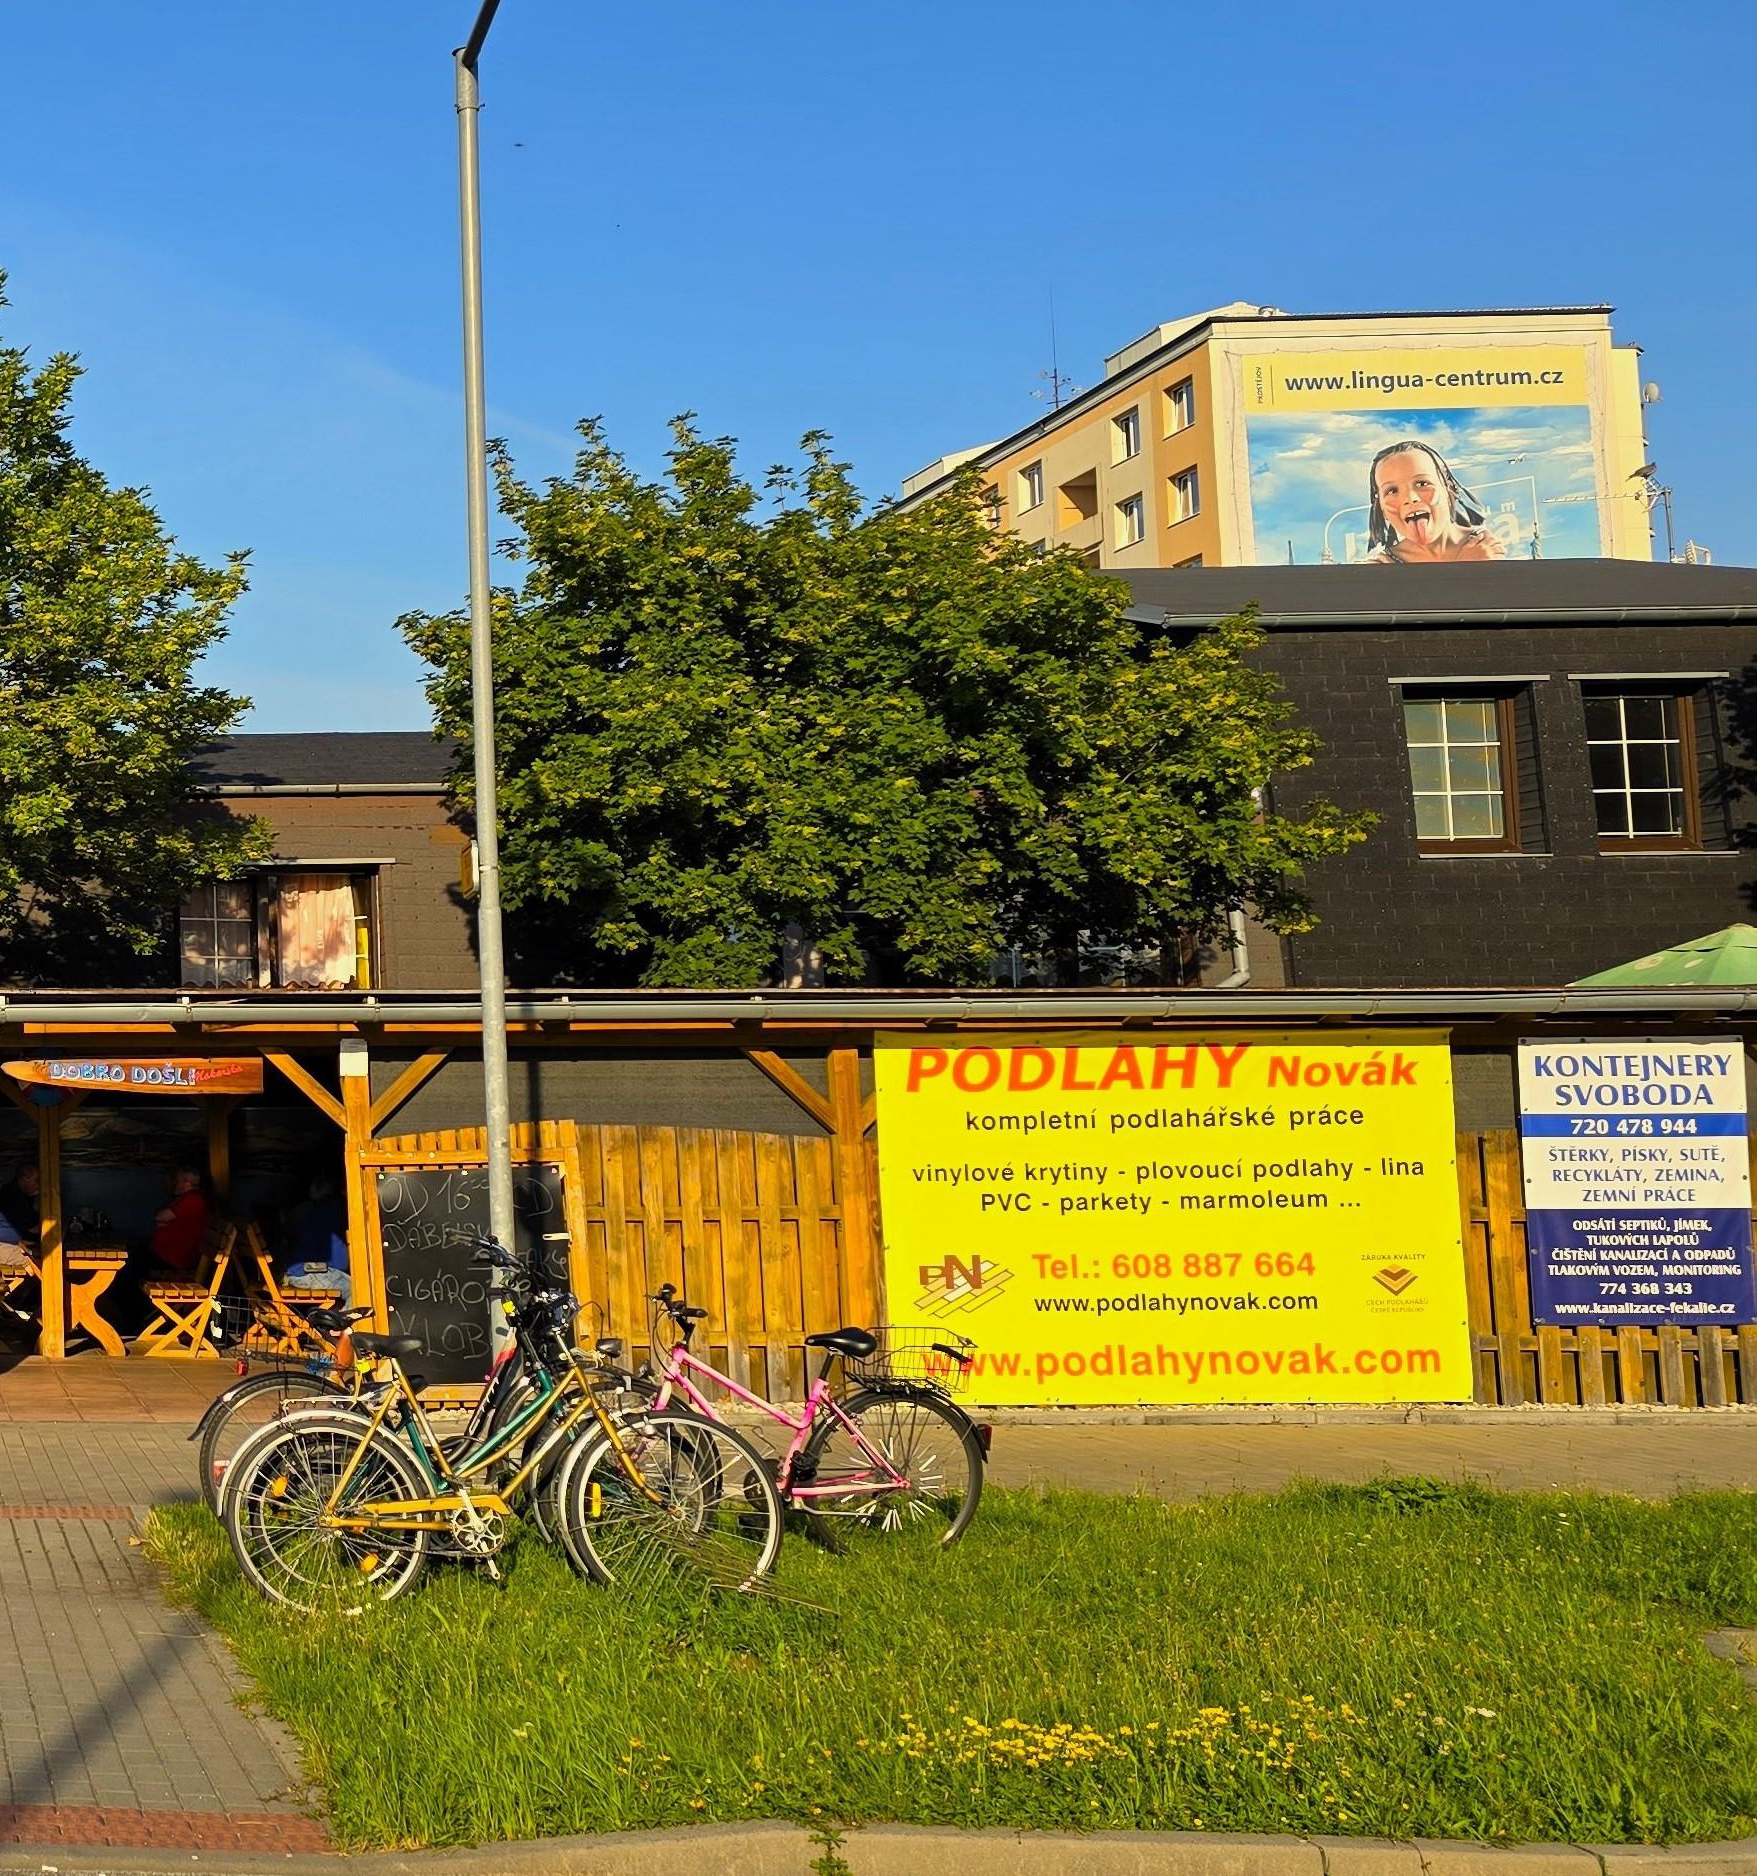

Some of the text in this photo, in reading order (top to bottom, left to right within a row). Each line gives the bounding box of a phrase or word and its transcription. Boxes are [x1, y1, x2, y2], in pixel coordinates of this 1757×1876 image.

[1284, 369, 1564, 394] www.lingua-centrum.cz
[50, 1061, 196, 1085] DOBRO DOŠLI
[906, 1042, 1419, 1093] PODLAHY Novák
[1534, 1054, 1732, 1081] KONTEJNERY
[1555, 1083, 1714, 1106] SVOBODA
[966, 1104, 1364, 1135] kompletní podlahářské práce
[1571, 1118, 1697, 1135] 720 478 944
[1549, 1145, 1613, 1163] ŠTĚRKY,
[1622, 1145, 1672, 1163] PÍSKY,
[913, 1162, 1014, 1186] vinylové
[1025, 1163, 1108, 1186] krytiny
[1136, 1157, 1242, 1184] plovoucí
[1253, 1159, 1353, 1182] podlahy
[1381, 1158, 1425, 1176] lina
[1552, 1166, 1725, 1184] RECYKLÁTY, ZEMINA,
[379, 1177, 429, 1224] OD
[981, 1193, 1032, 1212] PVC
[1061, 1192, 1151, 1215] parkety
[1180, 1190, 1328, 1209] marmoleum
[1583, 1186, 1696, 1202] ZEMNÍ PRÁCE
[1572, 1216, 1712, 1232] ODSÁTÍ SEPTIKŮ, JÍMEK,
[1586, 1232, 1699, 1246] TUKOVÝCH LAPOLŮ
[1032, 1252, 1316, 1279] Tel.: 608 887 664
[1552, 1246, 1736, 1261] ČIŠTĚNÍ KANALIZACÍ A ODPADŮ
[919, 1254, 982, 1290] PN
[1548, 1262, 1742, 1277] TLAKOVÝM VOZEM, MONITORING
[1599, 1283, 1626, 1295] 774
[1664, 1283, 1692, 1295] 343
[1034, 1292, 1318, 1316] www.podlahynovak.com
[1555, 1302, 1736, 1314] www.kanalizace-fekalie.cz
[923, 1343, 1441, 1384] www.podlahynovak.com
